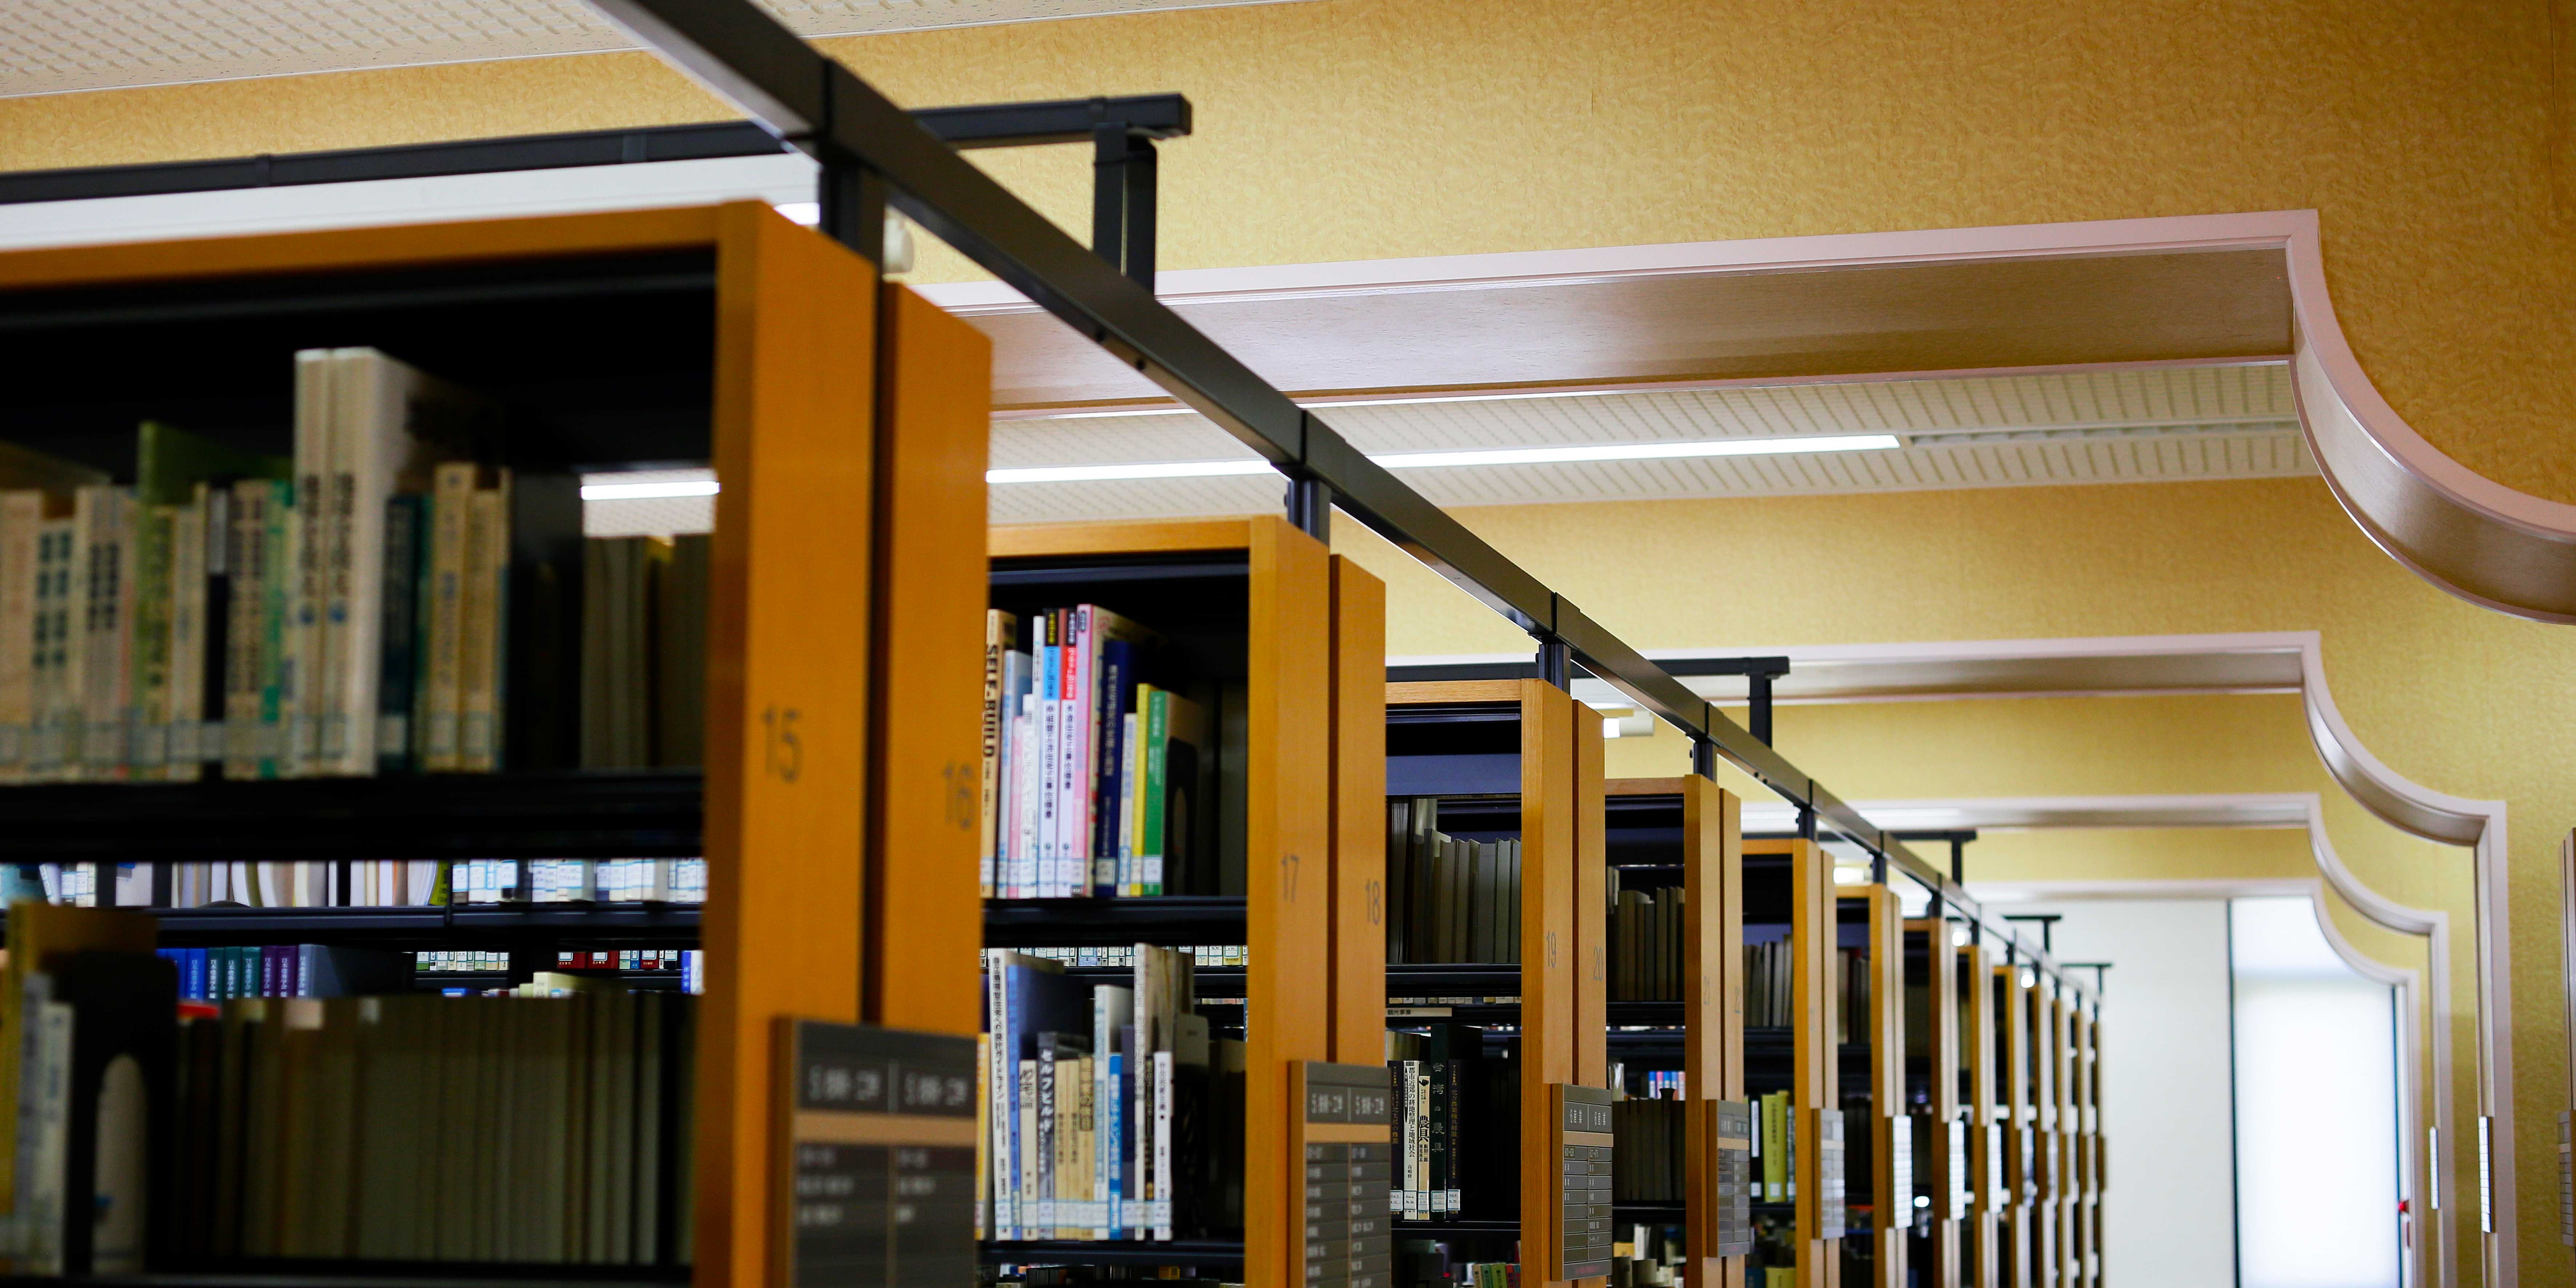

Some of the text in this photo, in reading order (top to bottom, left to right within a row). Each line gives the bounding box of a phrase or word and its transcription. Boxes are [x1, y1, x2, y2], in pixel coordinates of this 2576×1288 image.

[761, 705, 803, 783] 15
[1282, 853, 1299, 903] 17
[1365, 878, 1380, 925] 18
[1547, 930, 1556, 968] 19
[1594, 946, 1603, 981] 20
[1419, 1115, 1430, 1142] 農具
